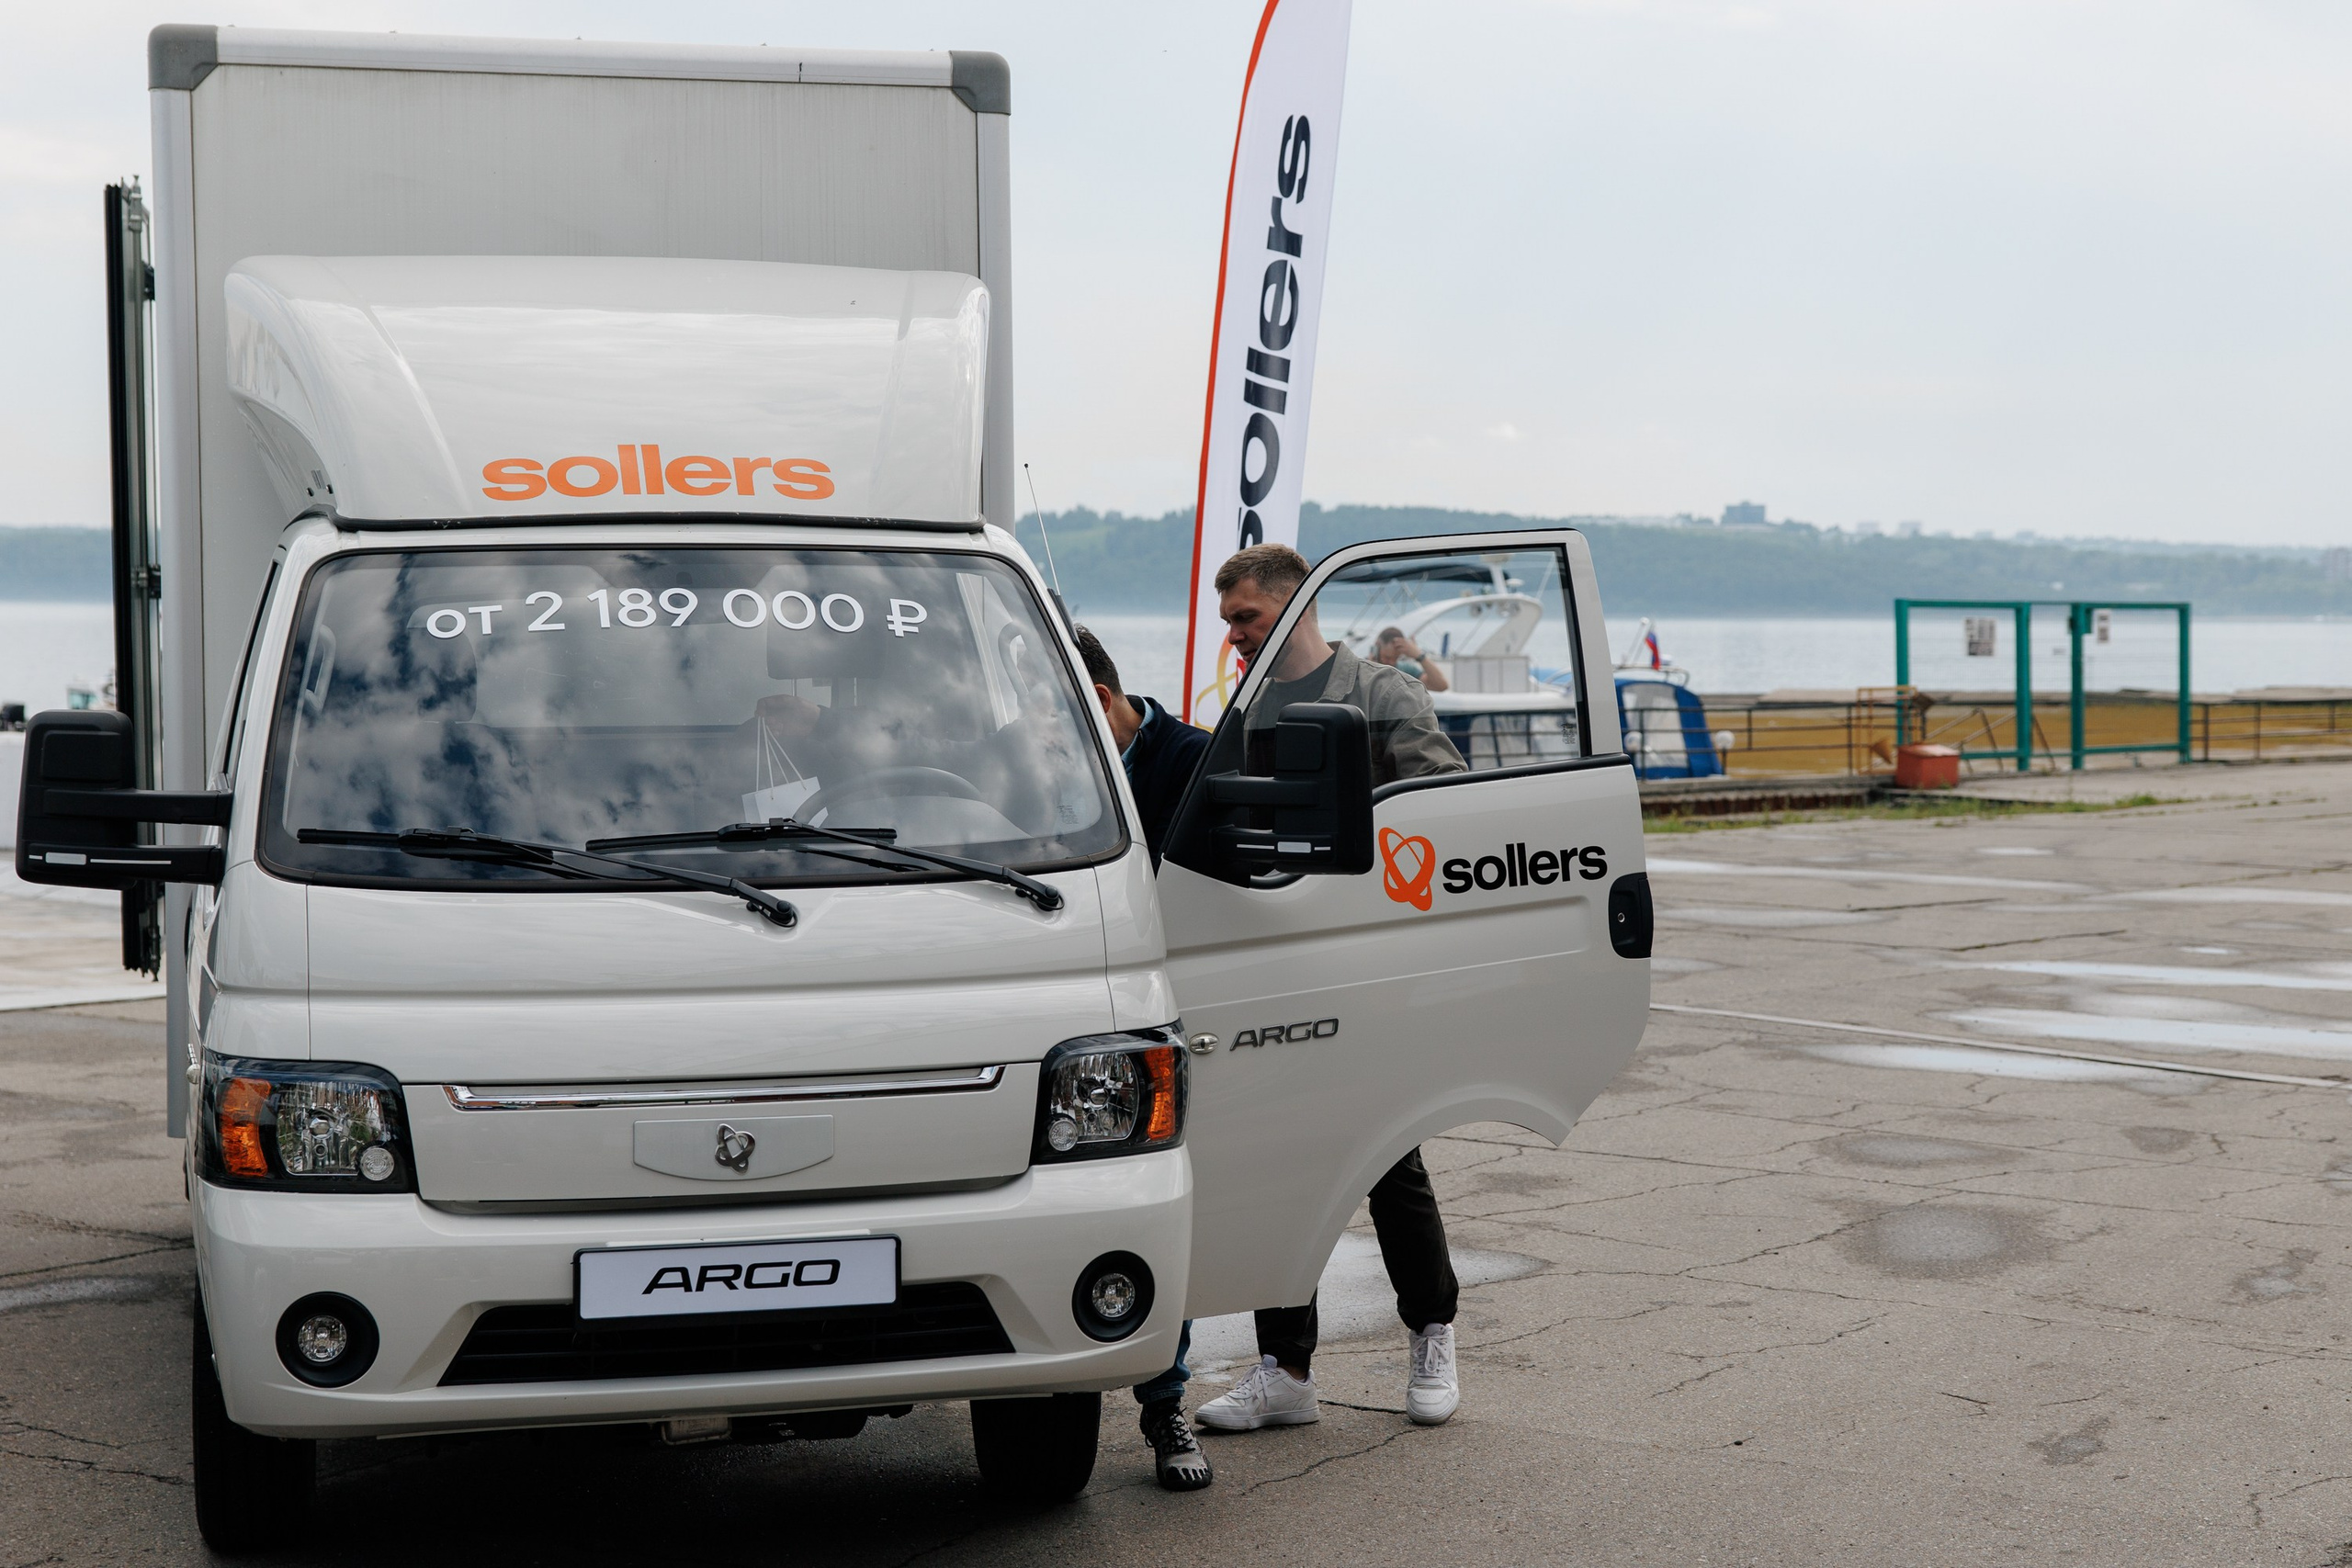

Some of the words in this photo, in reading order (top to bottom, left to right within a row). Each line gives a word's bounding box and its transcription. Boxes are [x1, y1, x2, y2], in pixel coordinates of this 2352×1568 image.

[481, 444, 835, 502] sollers
[525, 591, 565, 632] 2
[587, 587, 698, 628] 189
[721, 590, 865, 633] 000
[1442, 842, 1608, 894] sollers
[1229, 1017, 1340, 1052] ARGO
[641, 1258, 841, 1295] ARGO
